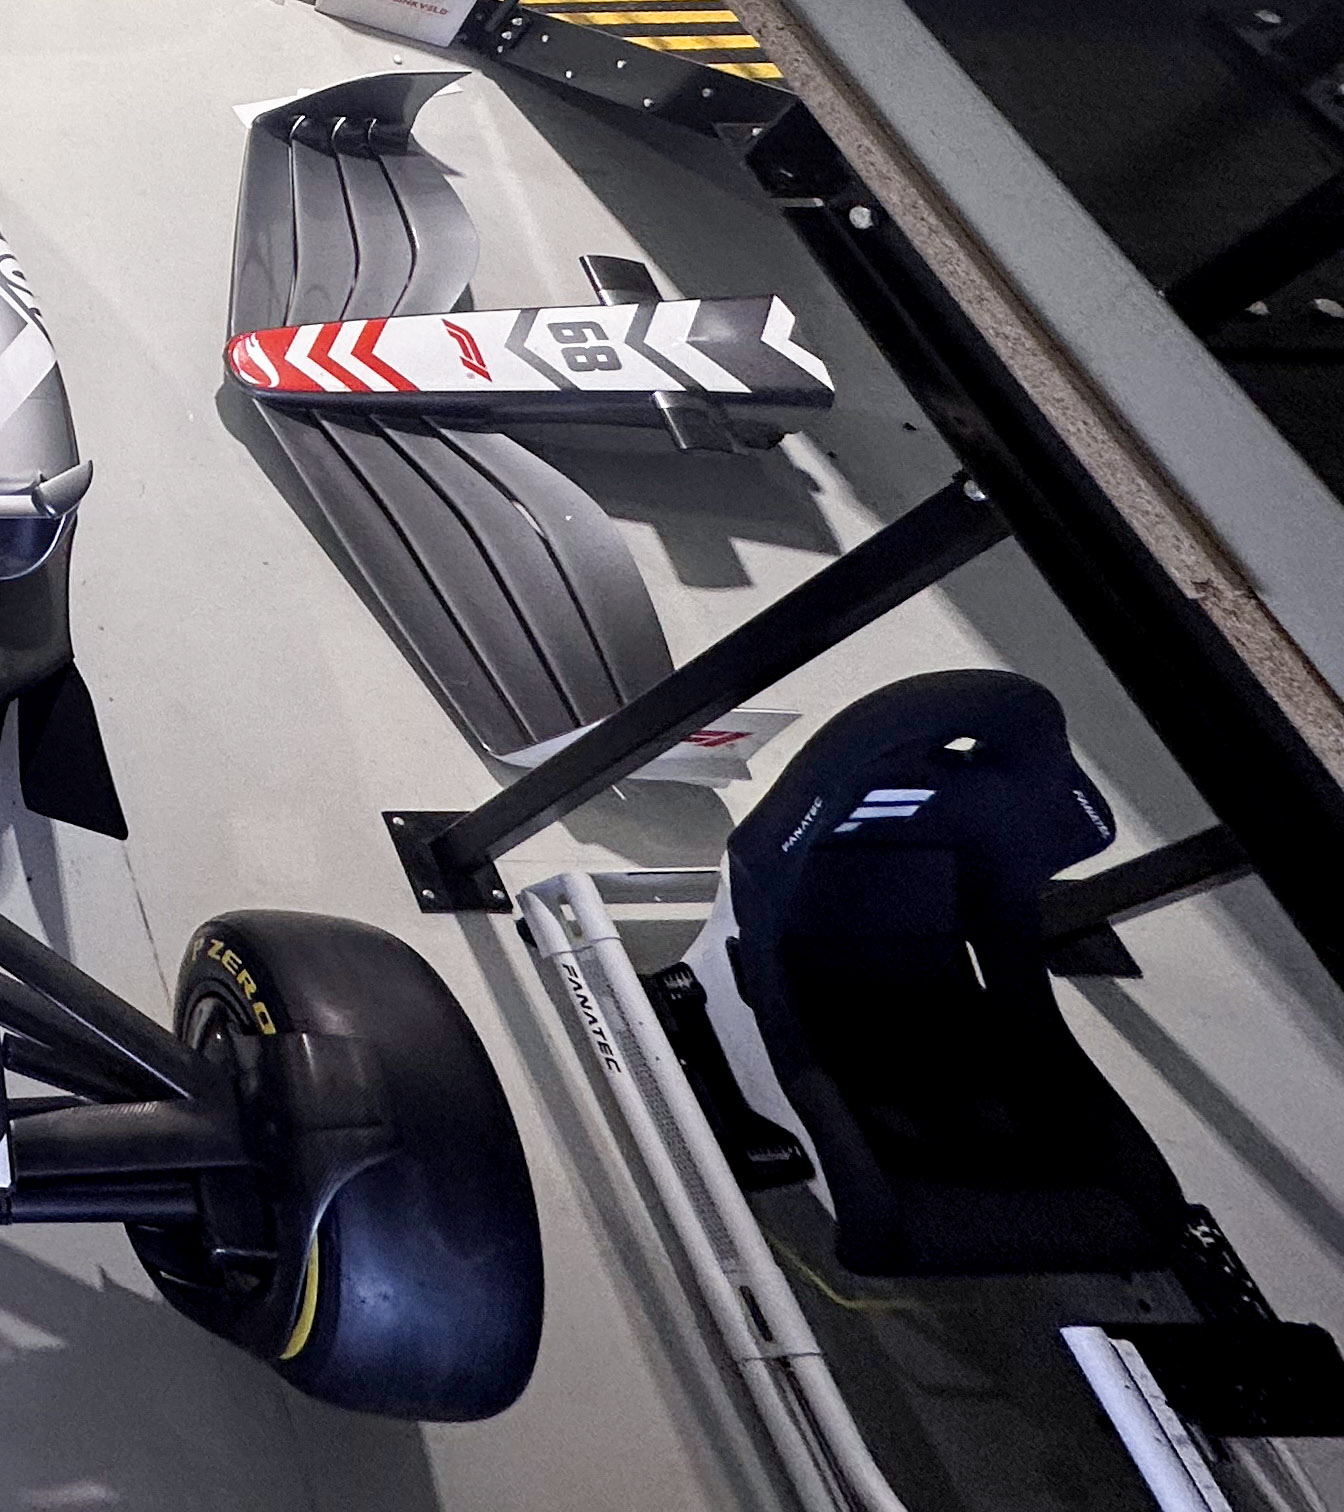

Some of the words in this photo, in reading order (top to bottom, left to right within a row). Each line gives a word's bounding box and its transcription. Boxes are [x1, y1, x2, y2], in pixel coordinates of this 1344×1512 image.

[441, 319, 493, 383] F1
[551, 320, 624, 373] 68
[208, 939, 277, 1035] ZERO
[561, 963, 622, 1073] FANATEC
